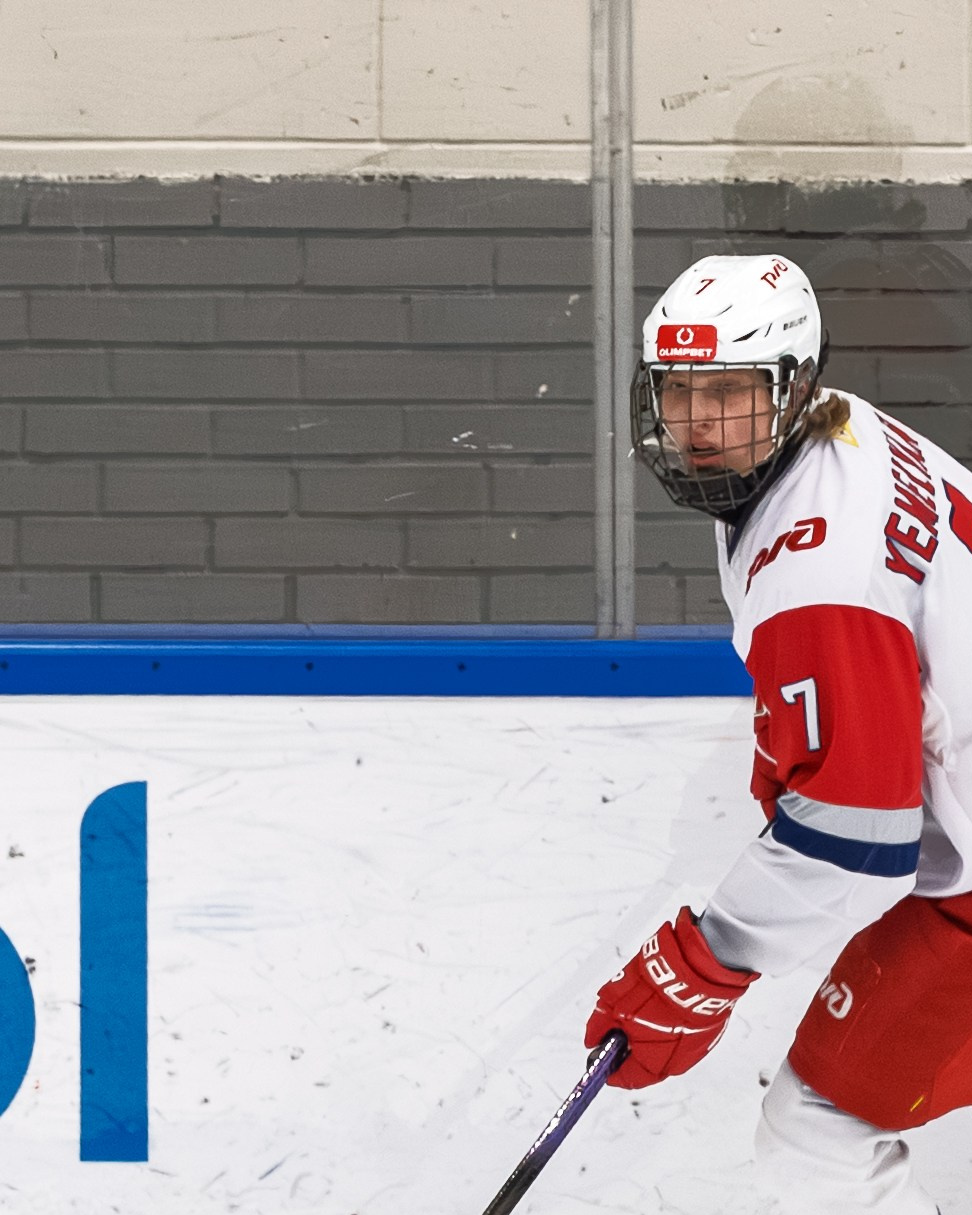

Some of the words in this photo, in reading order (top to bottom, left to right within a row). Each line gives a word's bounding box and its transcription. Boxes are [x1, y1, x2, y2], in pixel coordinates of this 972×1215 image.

[696, 279, 716, 295] 7
[659, 347, 713, 357] OLIMPBET
[780, 677, 821, 752] 7
